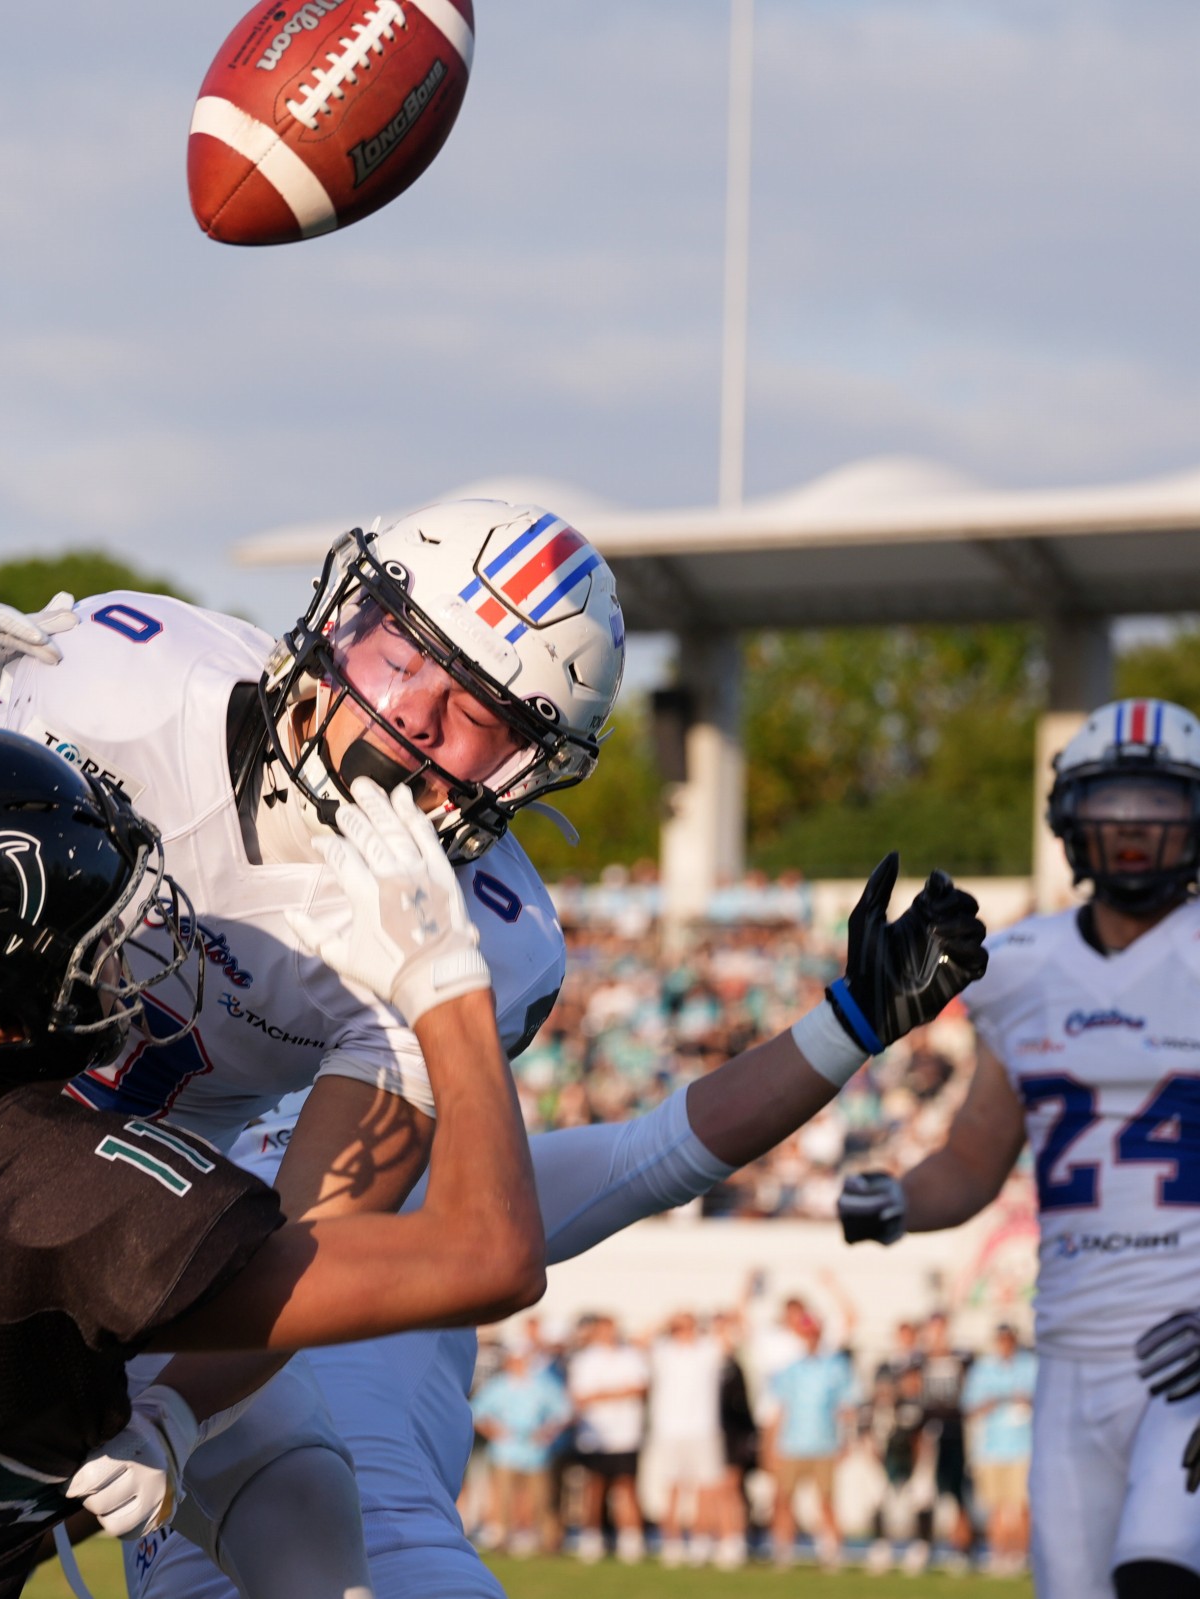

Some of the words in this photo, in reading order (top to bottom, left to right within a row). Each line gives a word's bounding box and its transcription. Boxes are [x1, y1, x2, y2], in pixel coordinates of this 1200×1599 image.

[91, 604, 163, 644] 0
[472, 869, 522, 923] 0
[141, 897, 254, 990] Cetors
[94, 1120, 216, 1197] 11
[1017, 1069, 1200, 1213] 24
